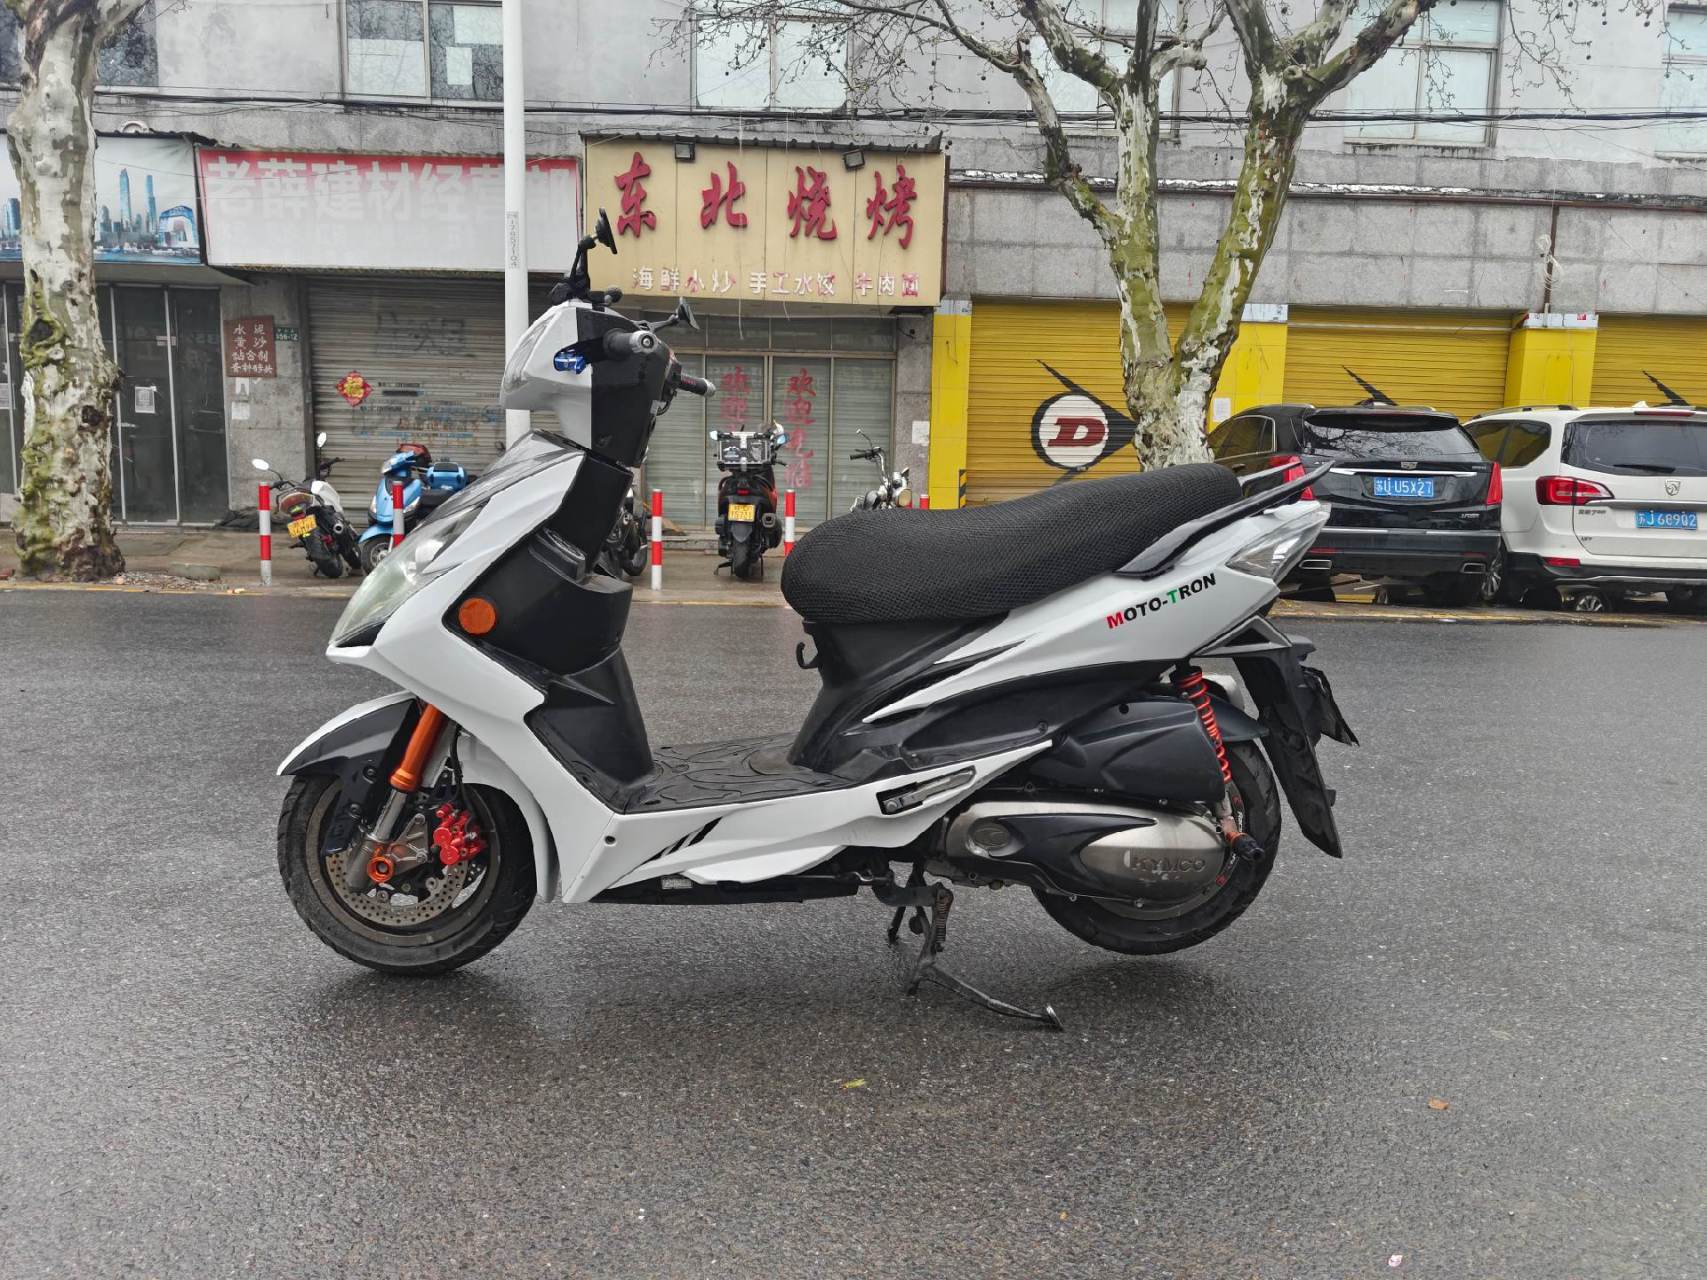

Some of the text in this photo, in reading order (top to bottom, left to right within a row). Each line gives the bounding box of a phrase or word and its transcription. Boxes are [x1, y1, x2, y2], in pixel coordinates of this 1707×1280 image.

[615, 152, 917, 249] 东北烧烤
[632, 267, 919, 298] 海鲜小炒 手工水饺 牛肉面
[1047, 417, 1106, 447] D
[1106, 573, 1216, 629] MOTO-TRON
